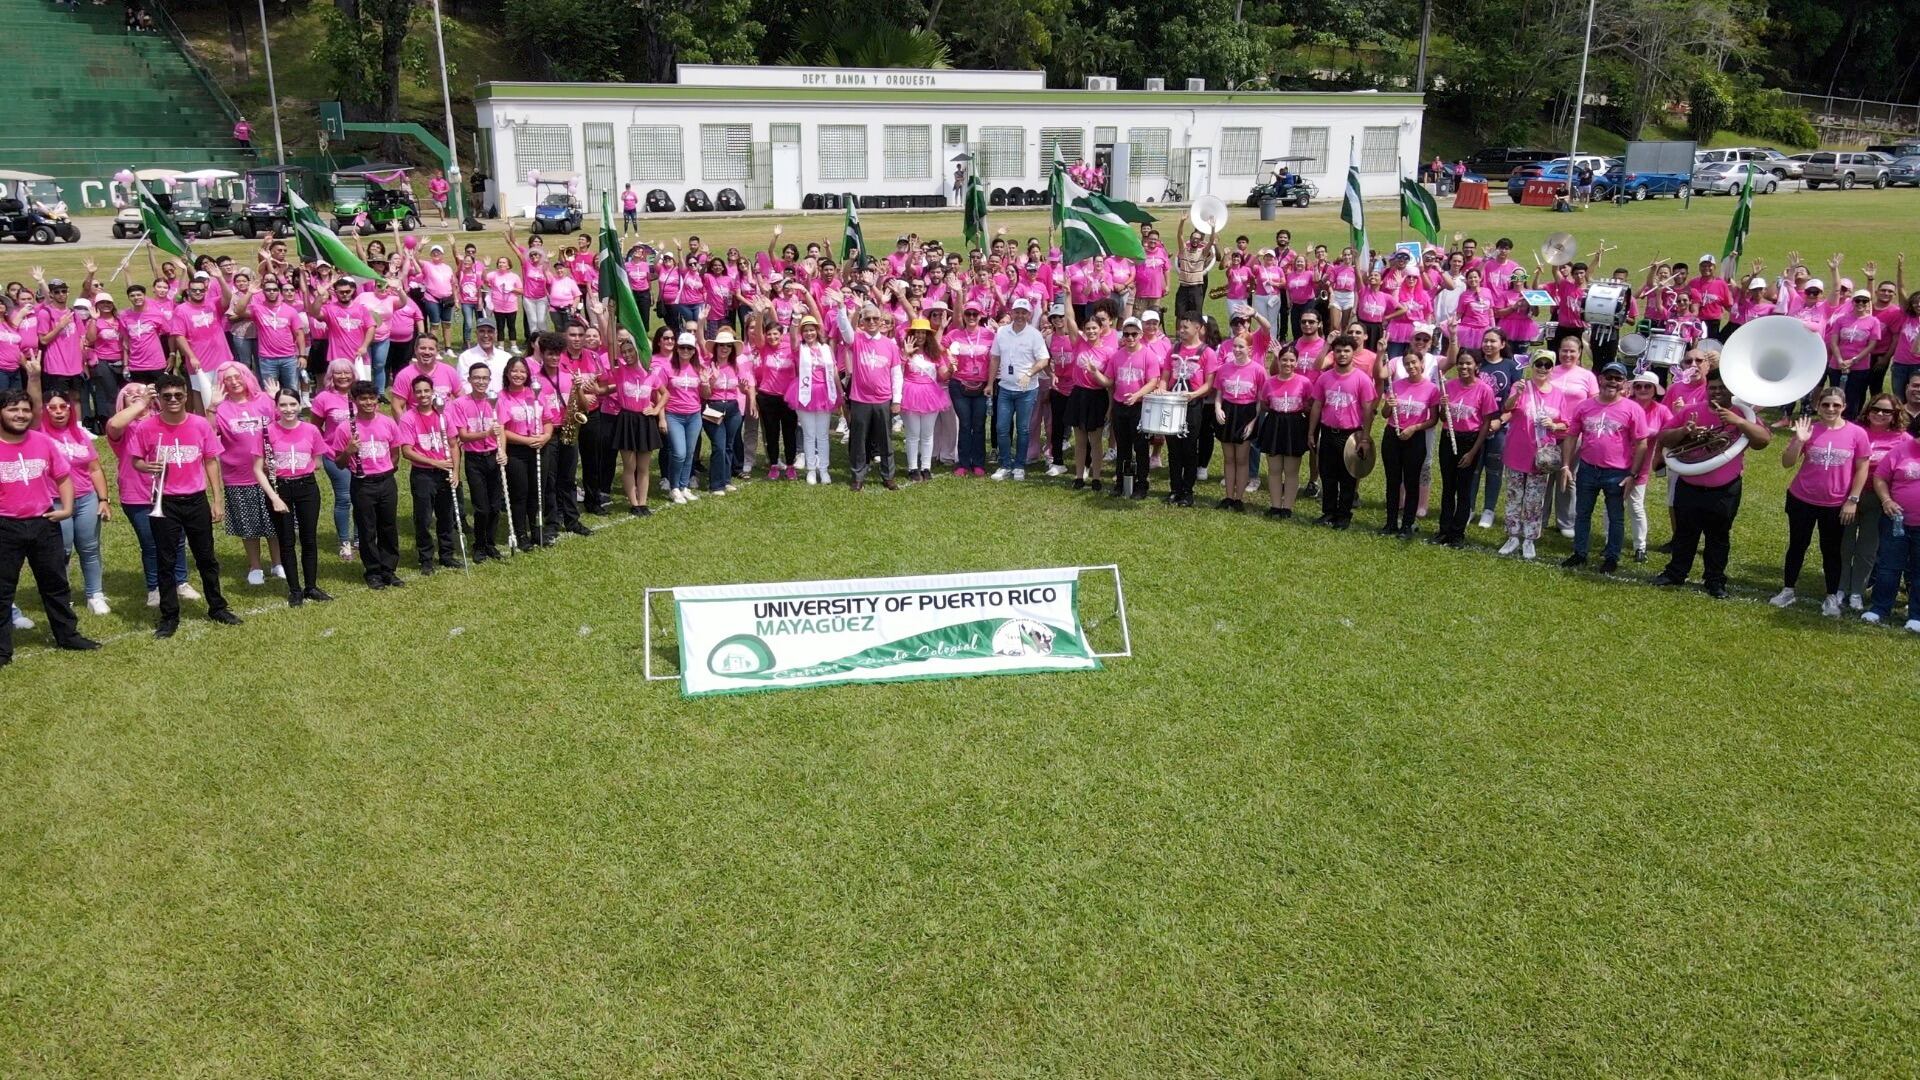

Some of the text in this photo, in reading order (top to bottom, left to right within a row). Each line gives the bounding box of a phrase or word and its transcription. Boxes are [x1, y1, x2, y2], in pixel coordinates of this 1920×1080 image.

[803, 74, 936, 85] DEPT. BANDA Y ORQUESTA
[754, 588, 1057, 619] UNIVERSITY OF PUERTO RICO
[756, 615, 875, 636] MAYAGÜEZ
[915, 633, 978, 657] Colegial
